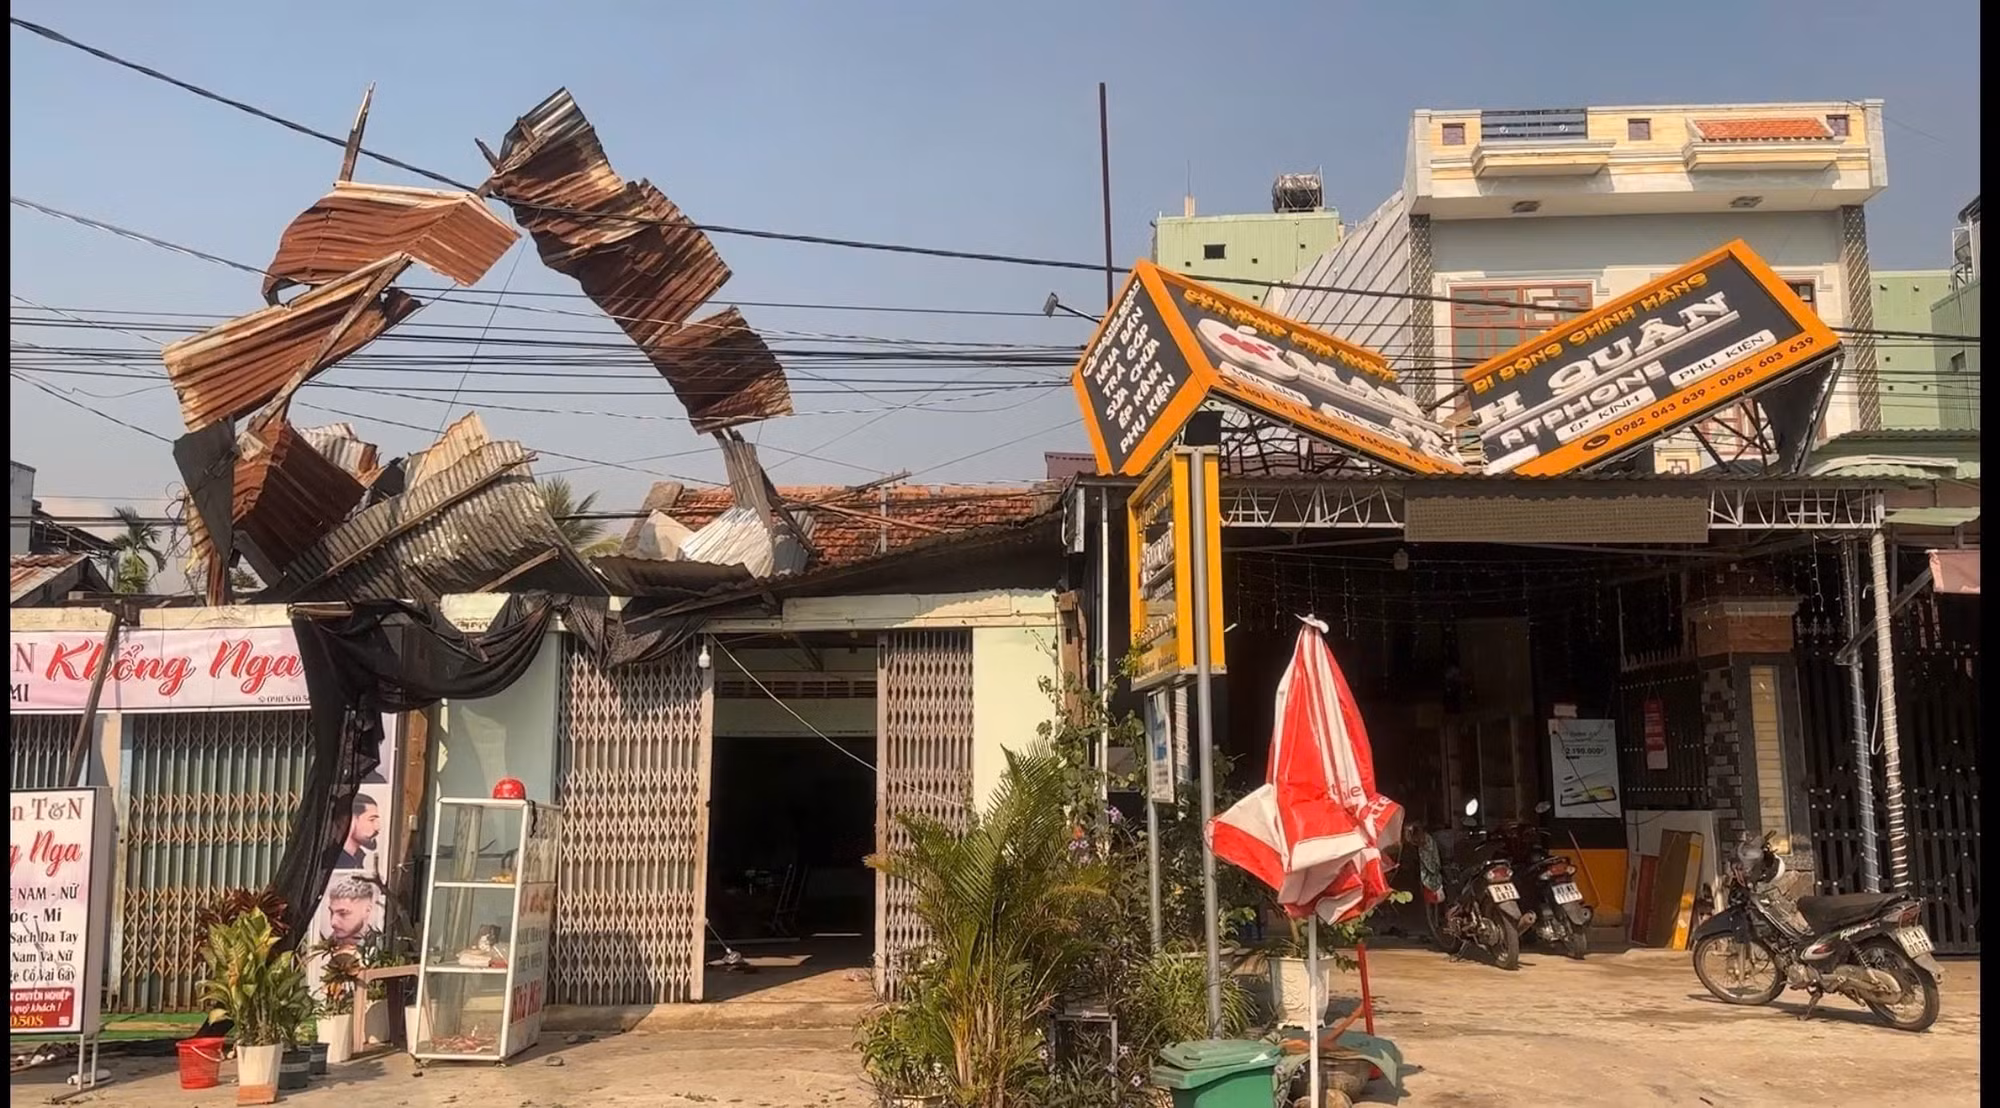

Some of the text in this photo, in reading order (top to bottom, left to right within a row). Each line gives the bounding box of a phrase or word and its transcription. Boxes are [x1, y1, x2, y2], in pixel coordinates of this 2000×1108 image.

[1095, 346, 1120, 386] MUA
[1120, 306, 1144, 345] BÁN
[1102, 362, 1126, 399] TRẢ
[1127, 323, 1149, 361] GÓP
[1548, 291, 1727, 396] QUÂN
[1106, 386, 1129, 421] SỬA
[1118, 360, 1163, 430] ÉP KÍNH
[1472, 376, 1495, 395] DI
[1614, 417, 1647, 437] 0982
[1651, 403, 1677, 419] 043
[1682, 389, 1706, 405] 639
[1719, 367, 1754, 387] 0965
[1758, 352, 1784, 368] 603
[1789, 336, 1815, 354] 639
[1120, 373, 1176, 454] PHỤ KIỆN
[1569, 395, 1640, 433] ÉP KÍNH
[46, 638, 197, 698] Khổng
[209, 638, 304, 695] Nga
[31, 797, 84, 821] T&N
[29, 829, 83, 878] Nga
[18, 887, 46, 900] NAM
[60, 883, 80, 900] NỮ
[43, 908, 62, 922] Mi
[12, 951, 36, 963] Nam
[57, 950, 73, 962] Nữ
[40, 931, 55, 943] Da
[60, 931, 78, 944] Tay
